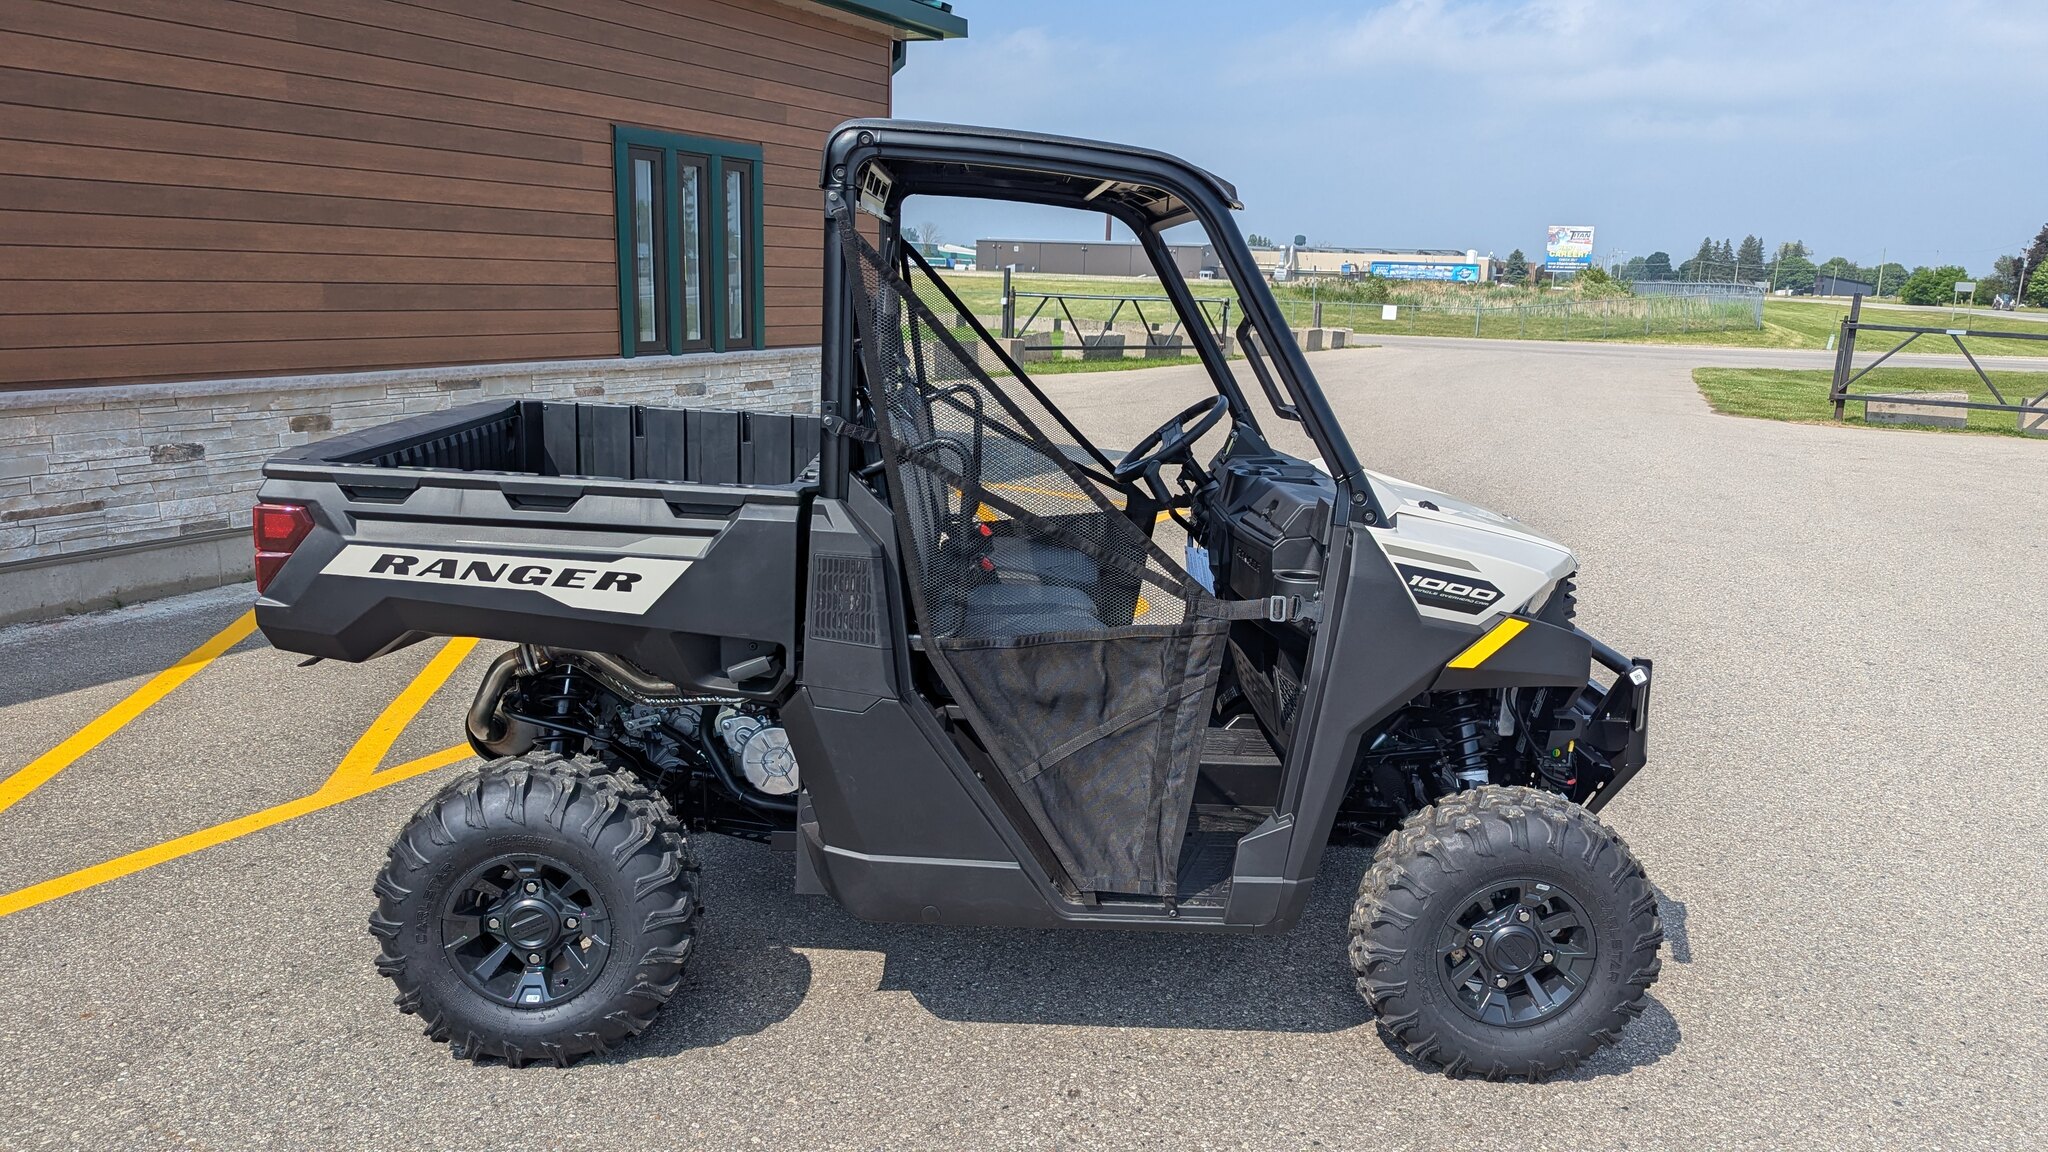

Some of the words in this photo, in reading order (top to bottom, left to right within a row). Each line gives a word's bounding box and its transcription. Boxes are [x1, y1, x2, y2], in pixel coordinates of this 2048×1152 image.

[1570, 231, 1592, 240] TITAN
[368, 553, 643, 593] RANGER
[1408, 575, 1498, 601] 1000
[1439, 593, 1474, 603] OVERHEAD
